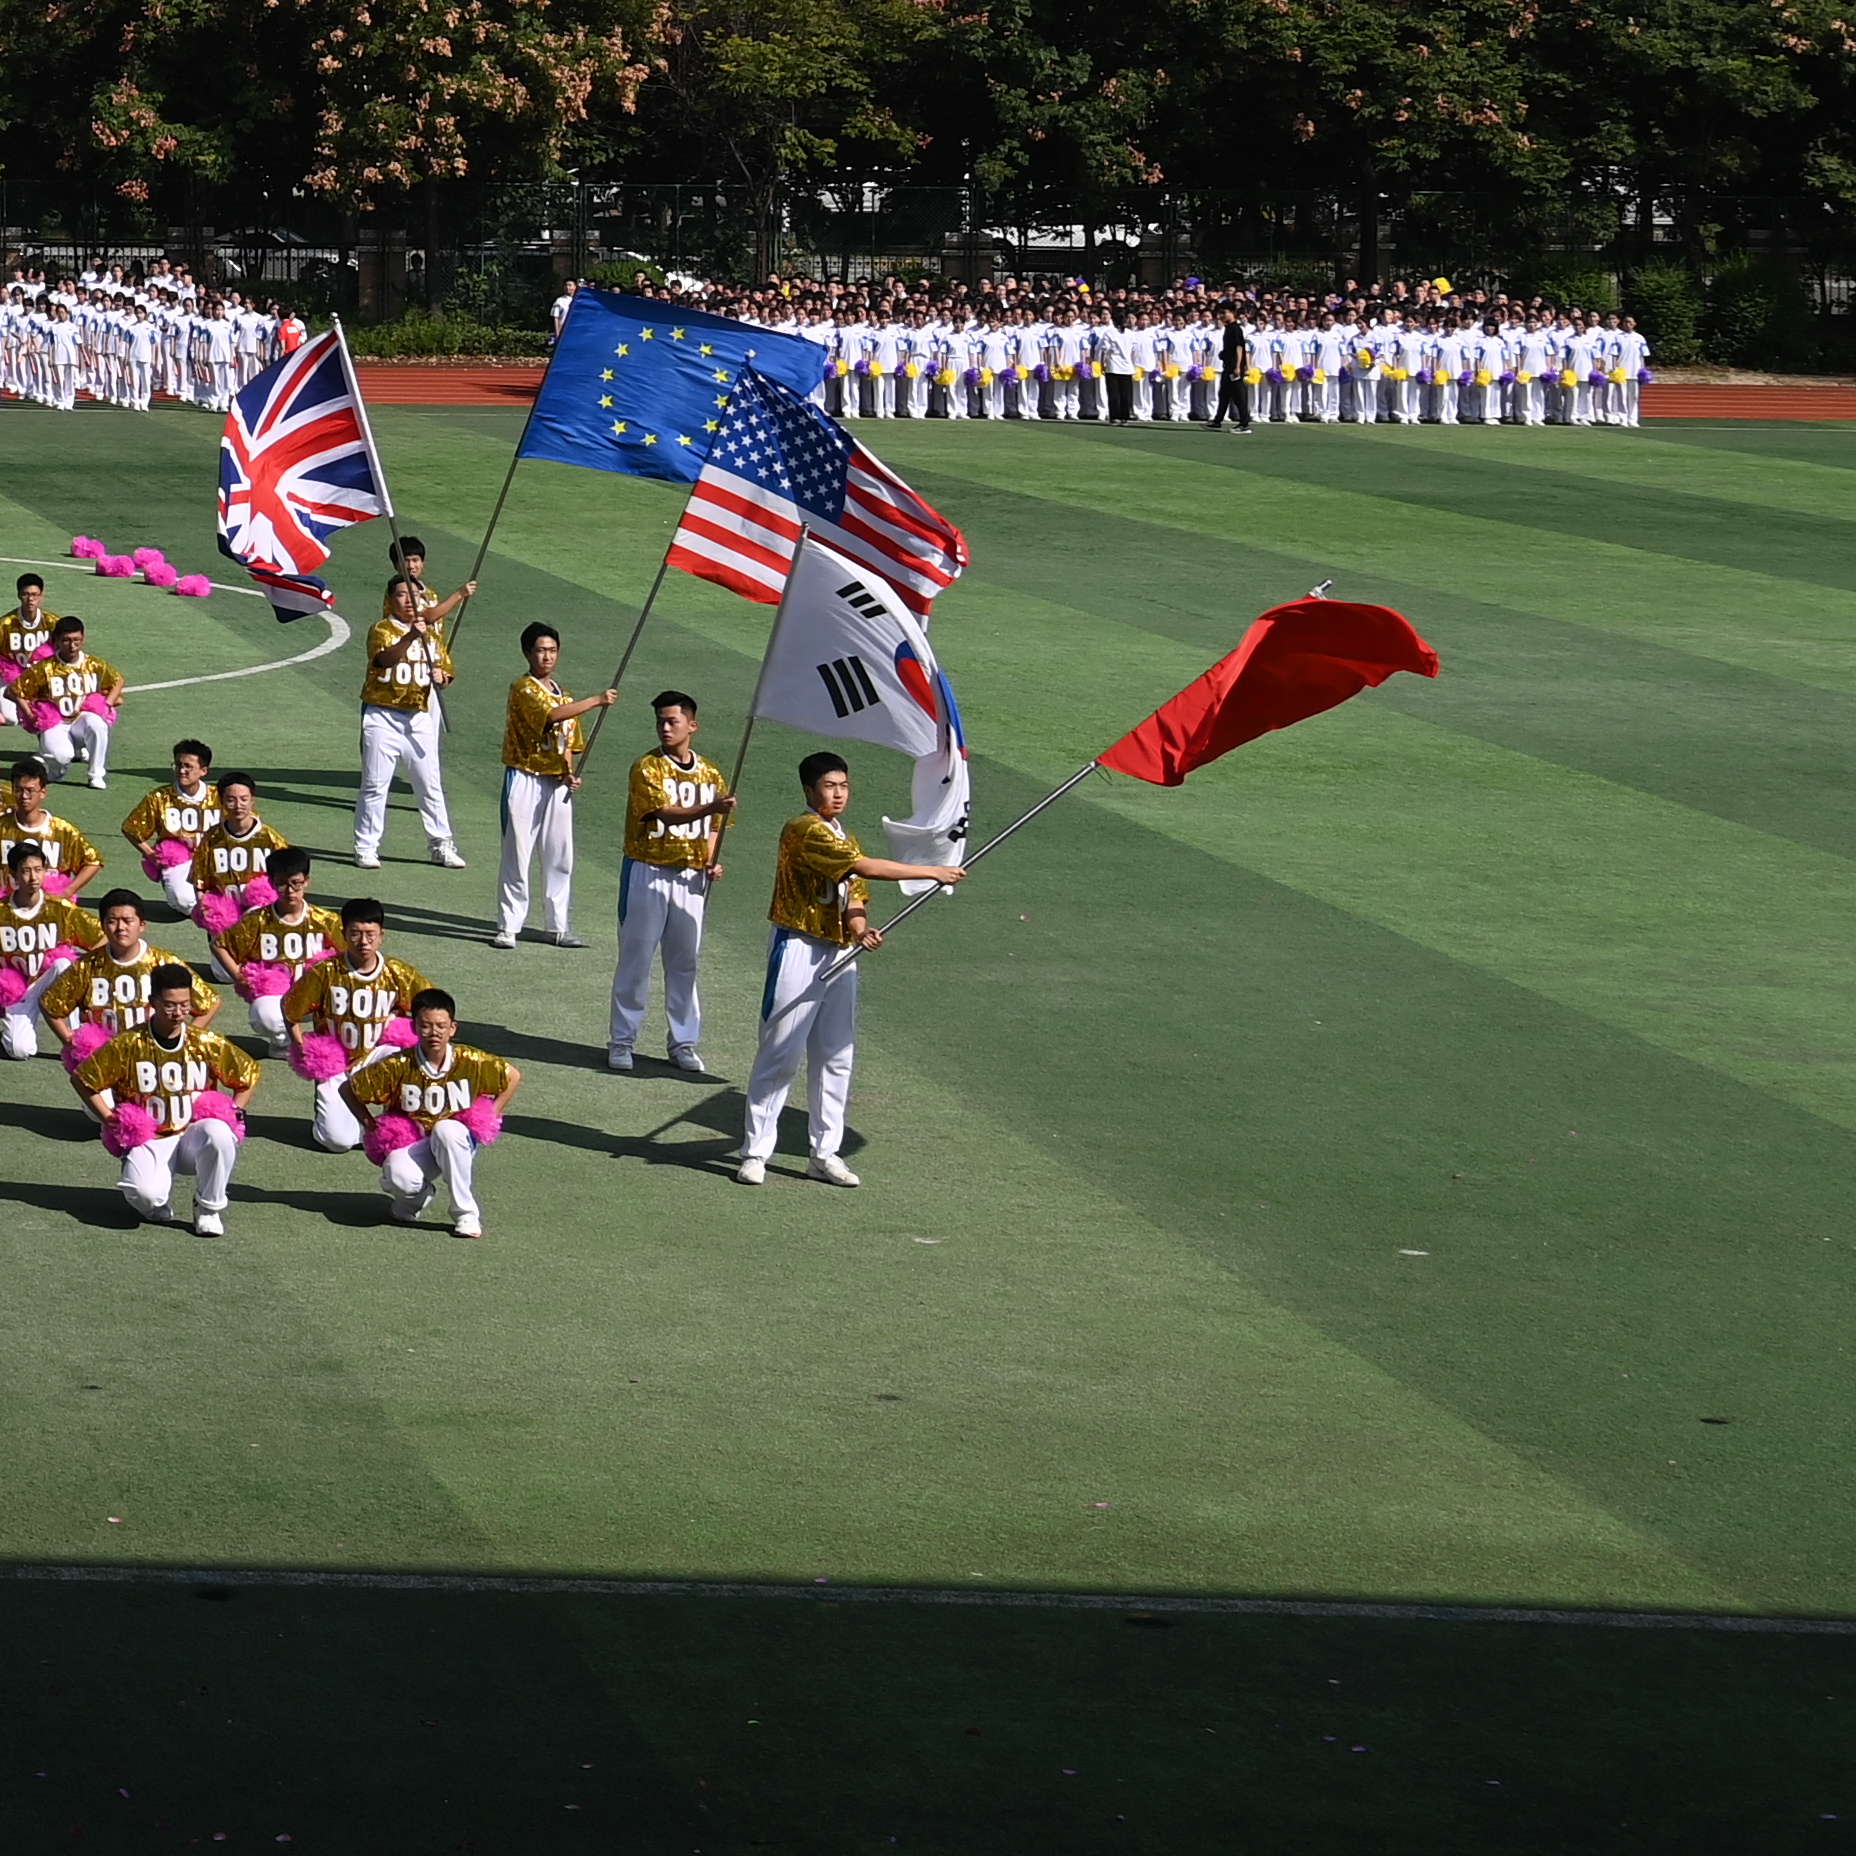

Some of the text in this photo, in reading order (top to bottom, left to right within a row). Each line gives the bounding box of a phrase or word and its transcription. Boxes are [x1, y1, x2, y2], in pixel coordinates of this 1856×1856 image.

[50, 672, 98, 697] BON
[165, 808, 221, 832] BON
[213, 847, 271, 873] BON
[0, 923, 58, 953] BON
[260, 932, 324, 961] BON
[330, 986, 397, 1019] BON
[136, 1061, 207, 1093] BON
[401, 1078, 472, 1117] BON
